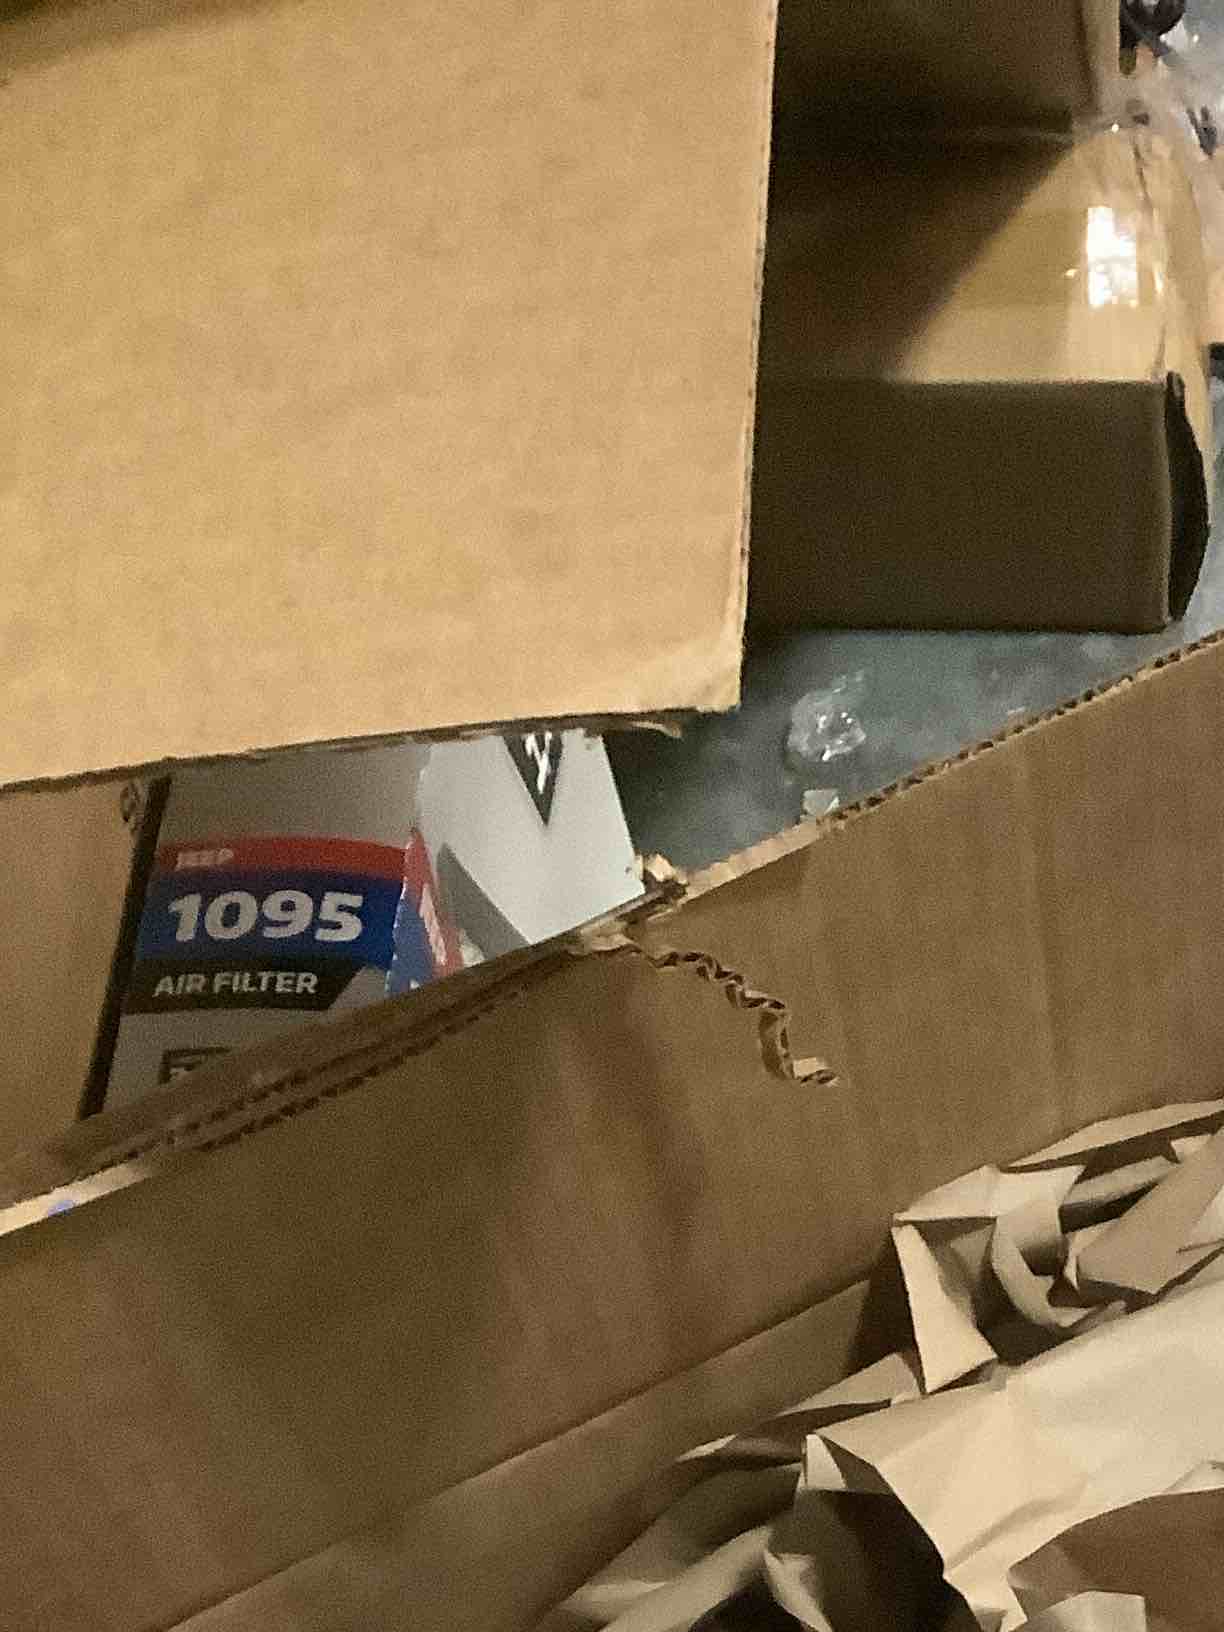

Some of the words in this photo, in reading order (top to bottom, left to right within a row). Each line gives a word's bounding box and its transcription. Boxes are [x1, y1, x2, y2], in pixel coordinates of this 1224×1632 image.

[168, 890, 363, 942] 1095
[151, 974, 205, 998] AIR
[213, 972, 319, 993] FILTER
